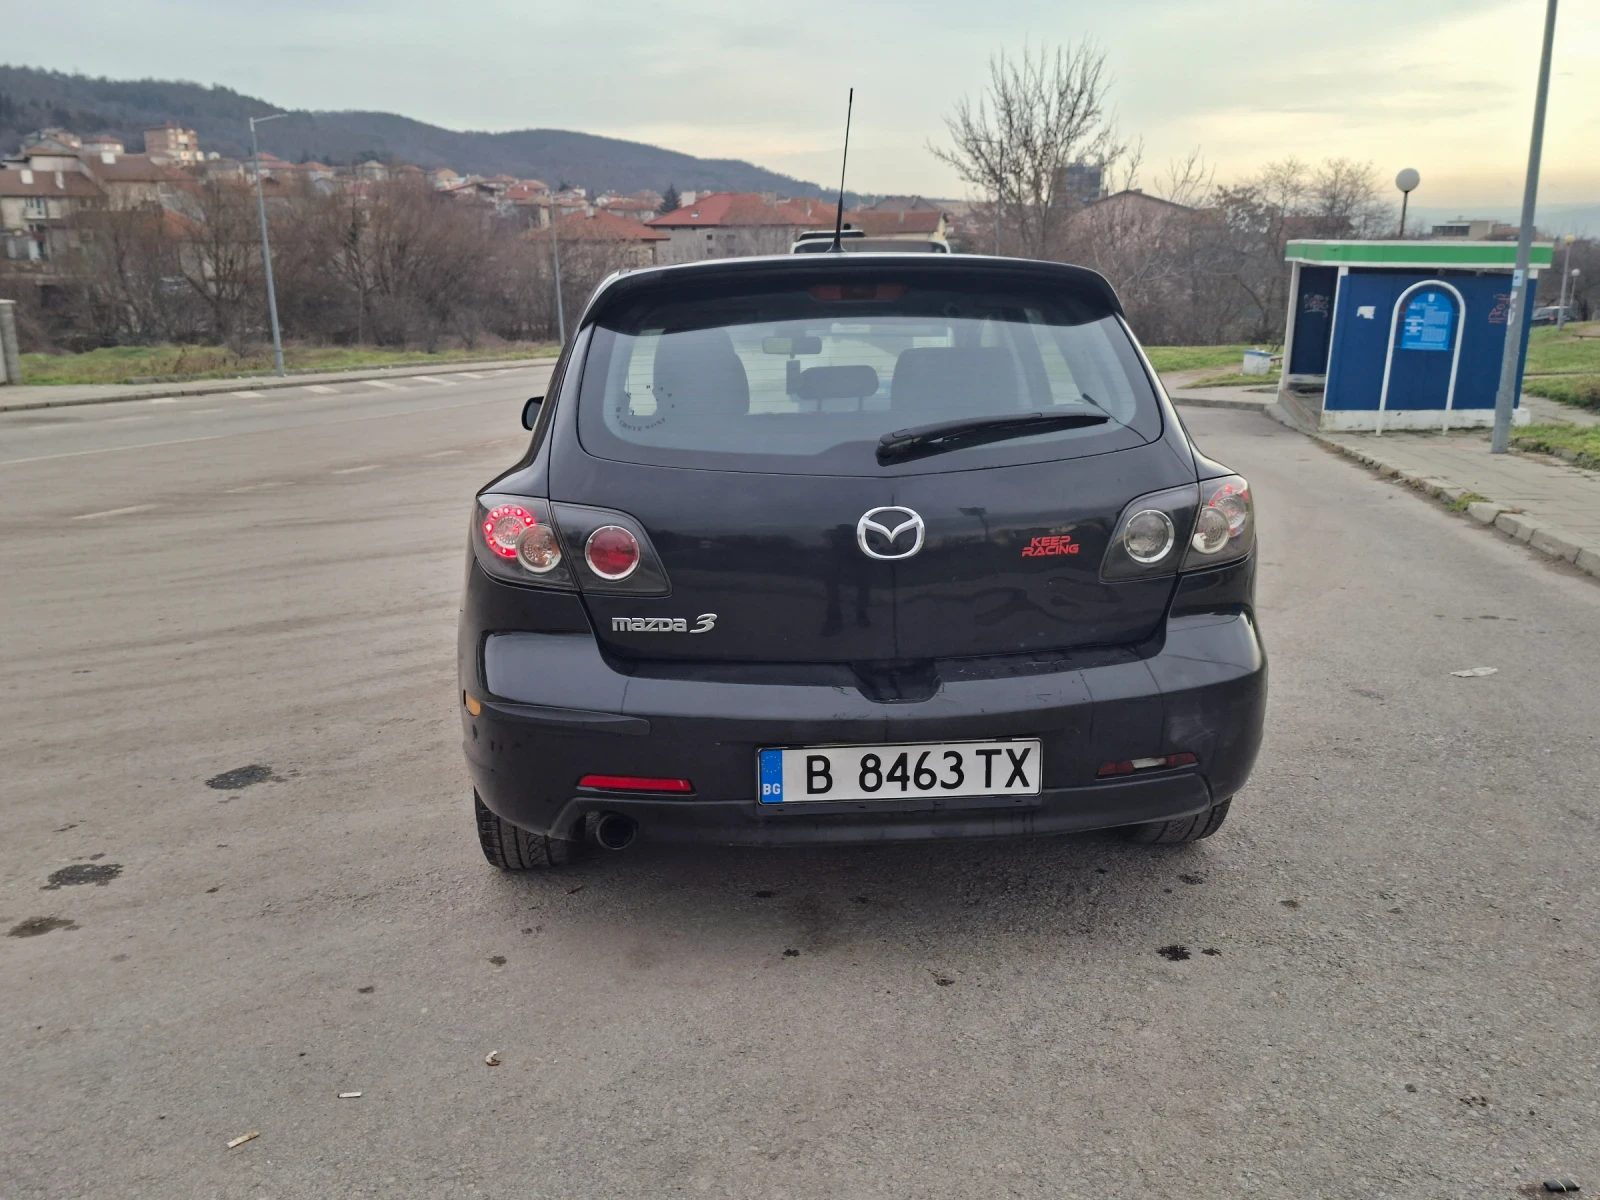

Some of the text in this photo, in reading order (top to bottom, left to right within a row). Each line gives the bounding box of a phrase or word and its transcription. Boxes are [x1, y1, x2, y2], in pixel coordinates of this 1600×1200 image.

[1031, 535, 1071, 547] KEEP
[1021, 543, 1080, 557] RACING
[611, 613, 718, 633] mazda 3
[806, 748, 1032, 795] B 8463 TX
[762, 783, 781, 796] BG
